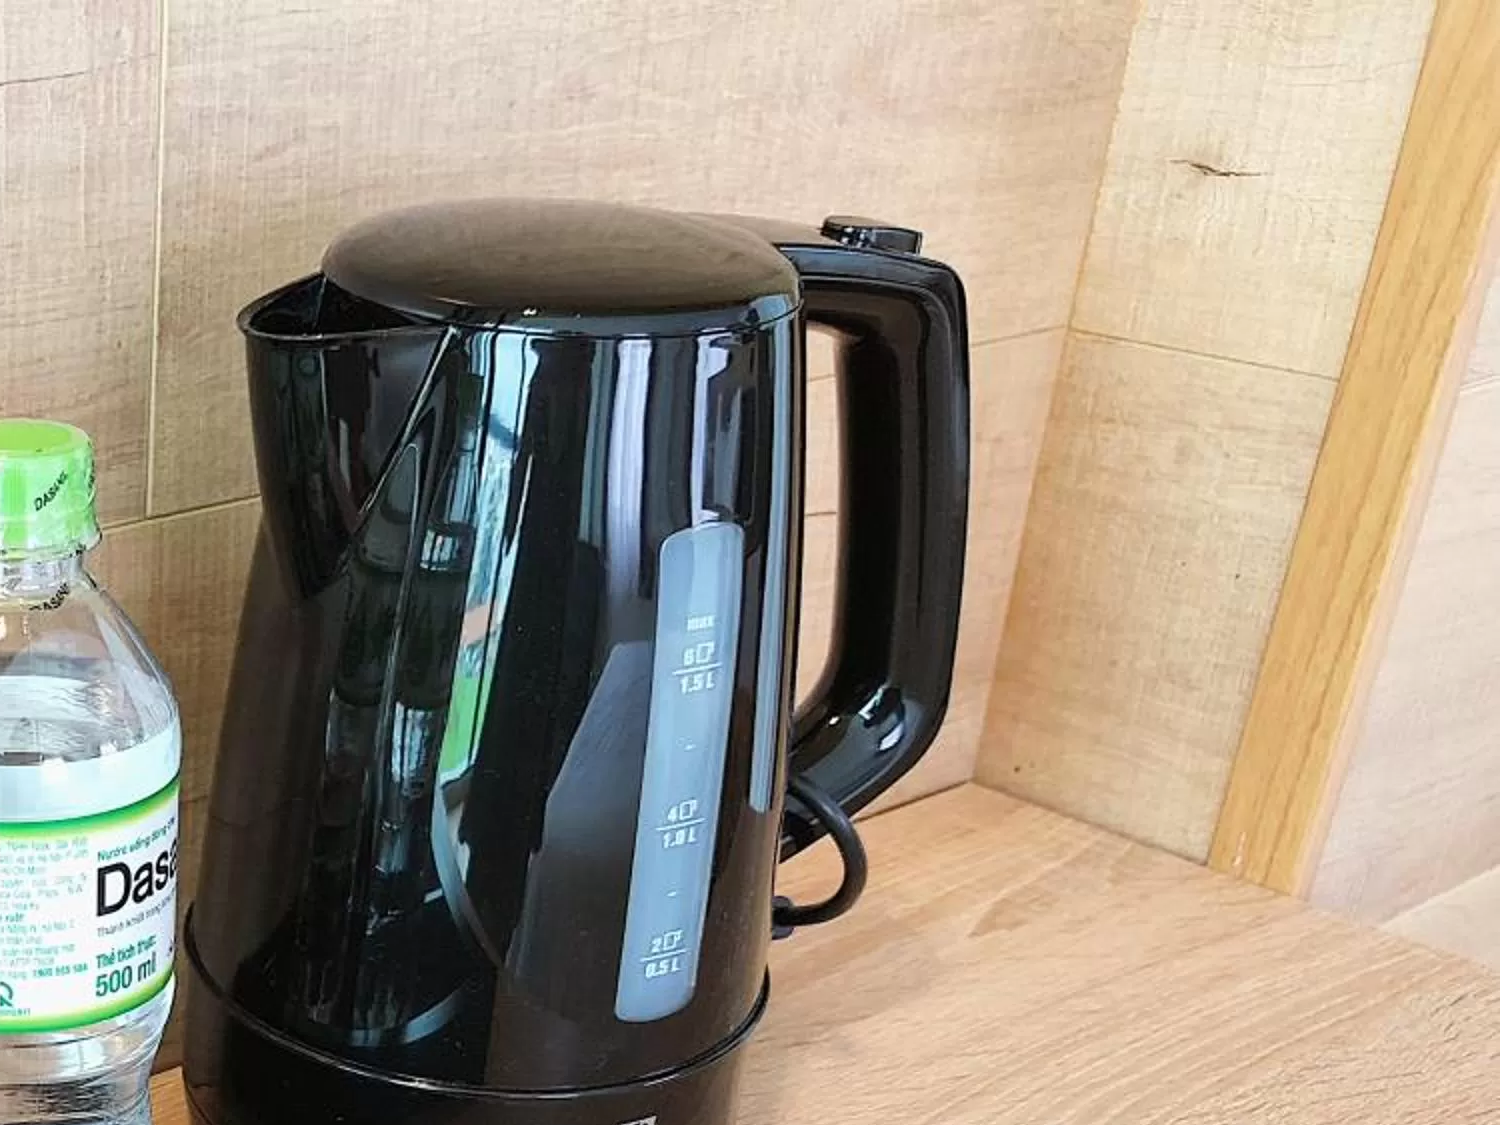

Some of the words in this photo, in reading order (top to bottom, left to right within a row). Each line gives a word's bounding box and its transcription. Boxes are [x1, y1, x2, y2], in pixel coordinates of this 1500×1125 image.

[667, 805, 677, 822] 4
[651, 937, 663, 953] 2
[95, 964, 133, 997] 500
[137, 951, 157, 982] ml
